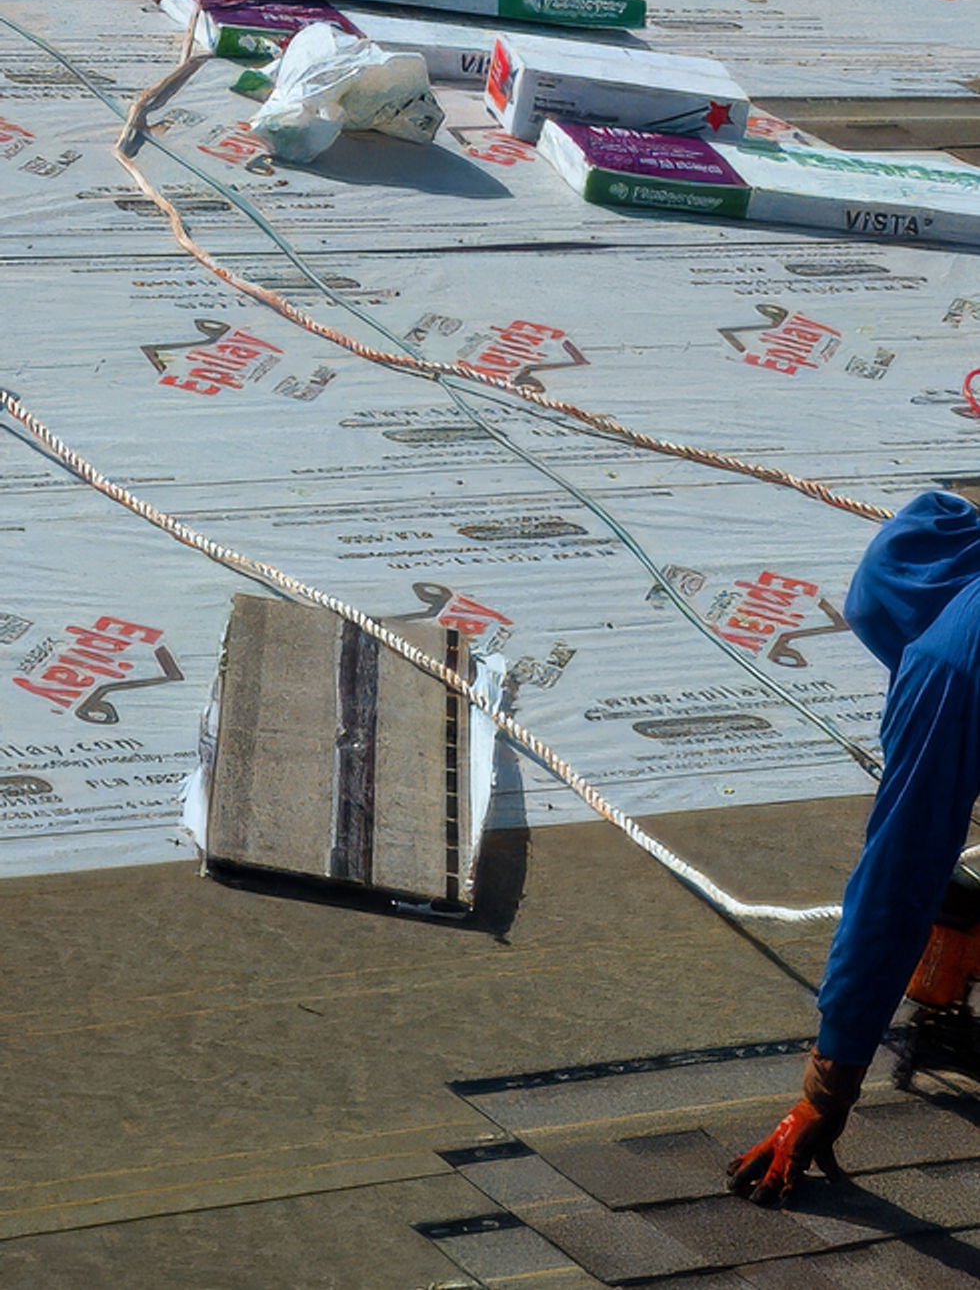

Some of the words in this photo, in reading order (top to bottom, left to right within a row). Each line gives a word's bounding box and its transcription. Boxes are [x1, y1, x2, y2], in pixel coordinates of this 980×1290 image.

[845, 210, 919, 235] VISTA
[158, 329, 284, 395] Epilay
[12, 616, 164, 709] Epilay
